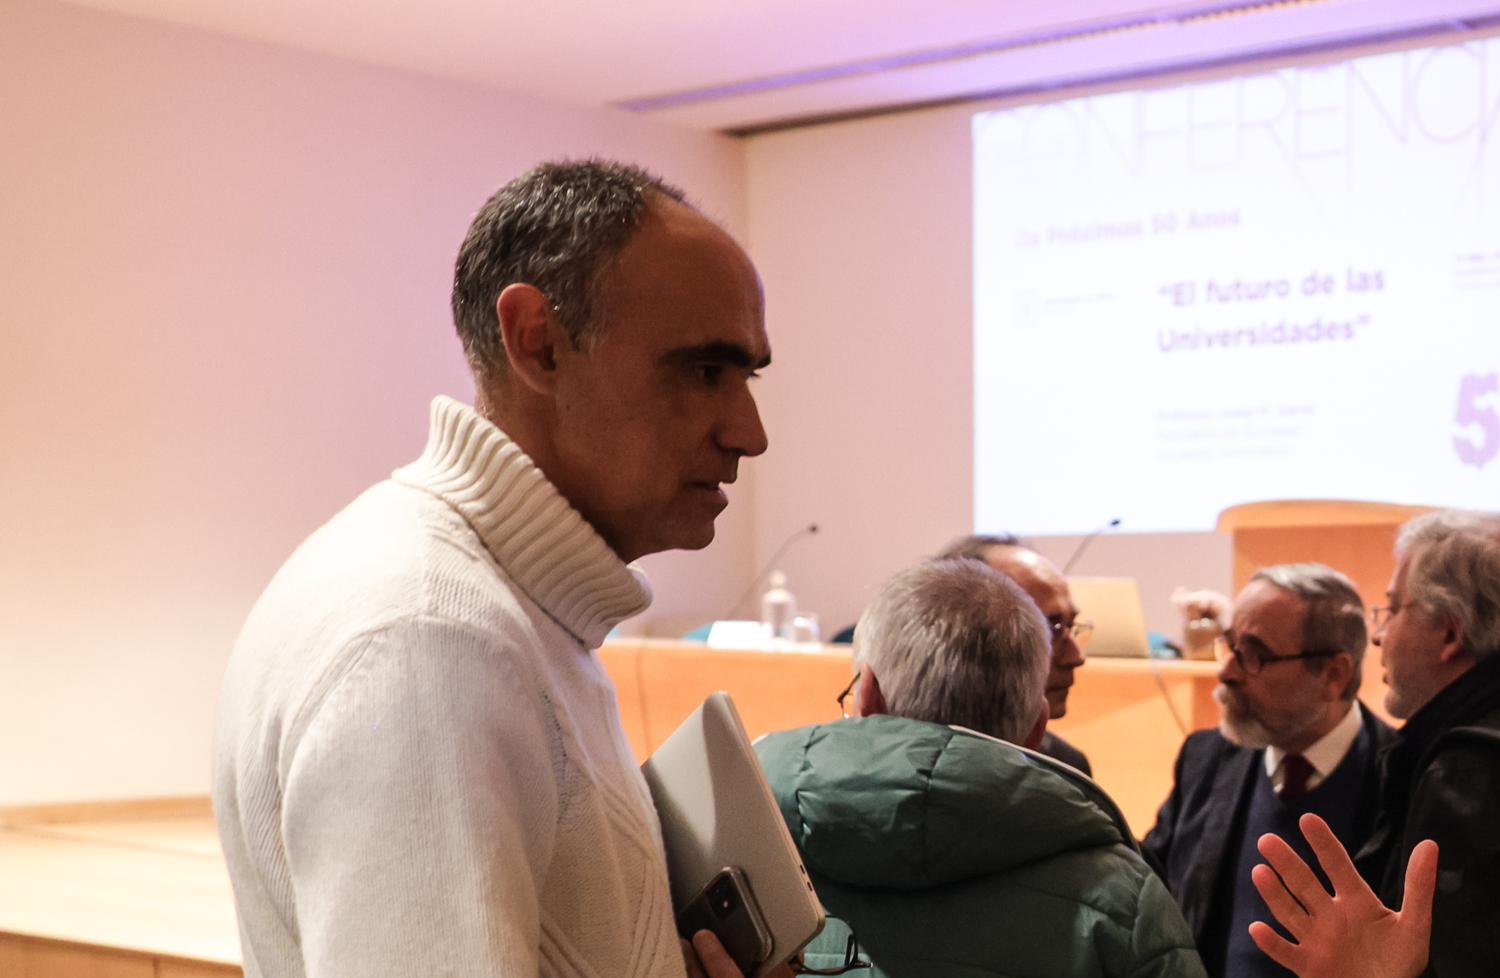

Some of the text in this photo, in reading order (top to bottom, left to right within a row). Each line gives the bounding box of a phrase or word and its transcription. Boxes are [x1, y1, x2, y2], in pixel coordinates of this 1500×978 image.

[1205, 276, 1290, 304] futuro
[1301, 267, 1336, 297] de
[1345, 265, 1386, 293] las
